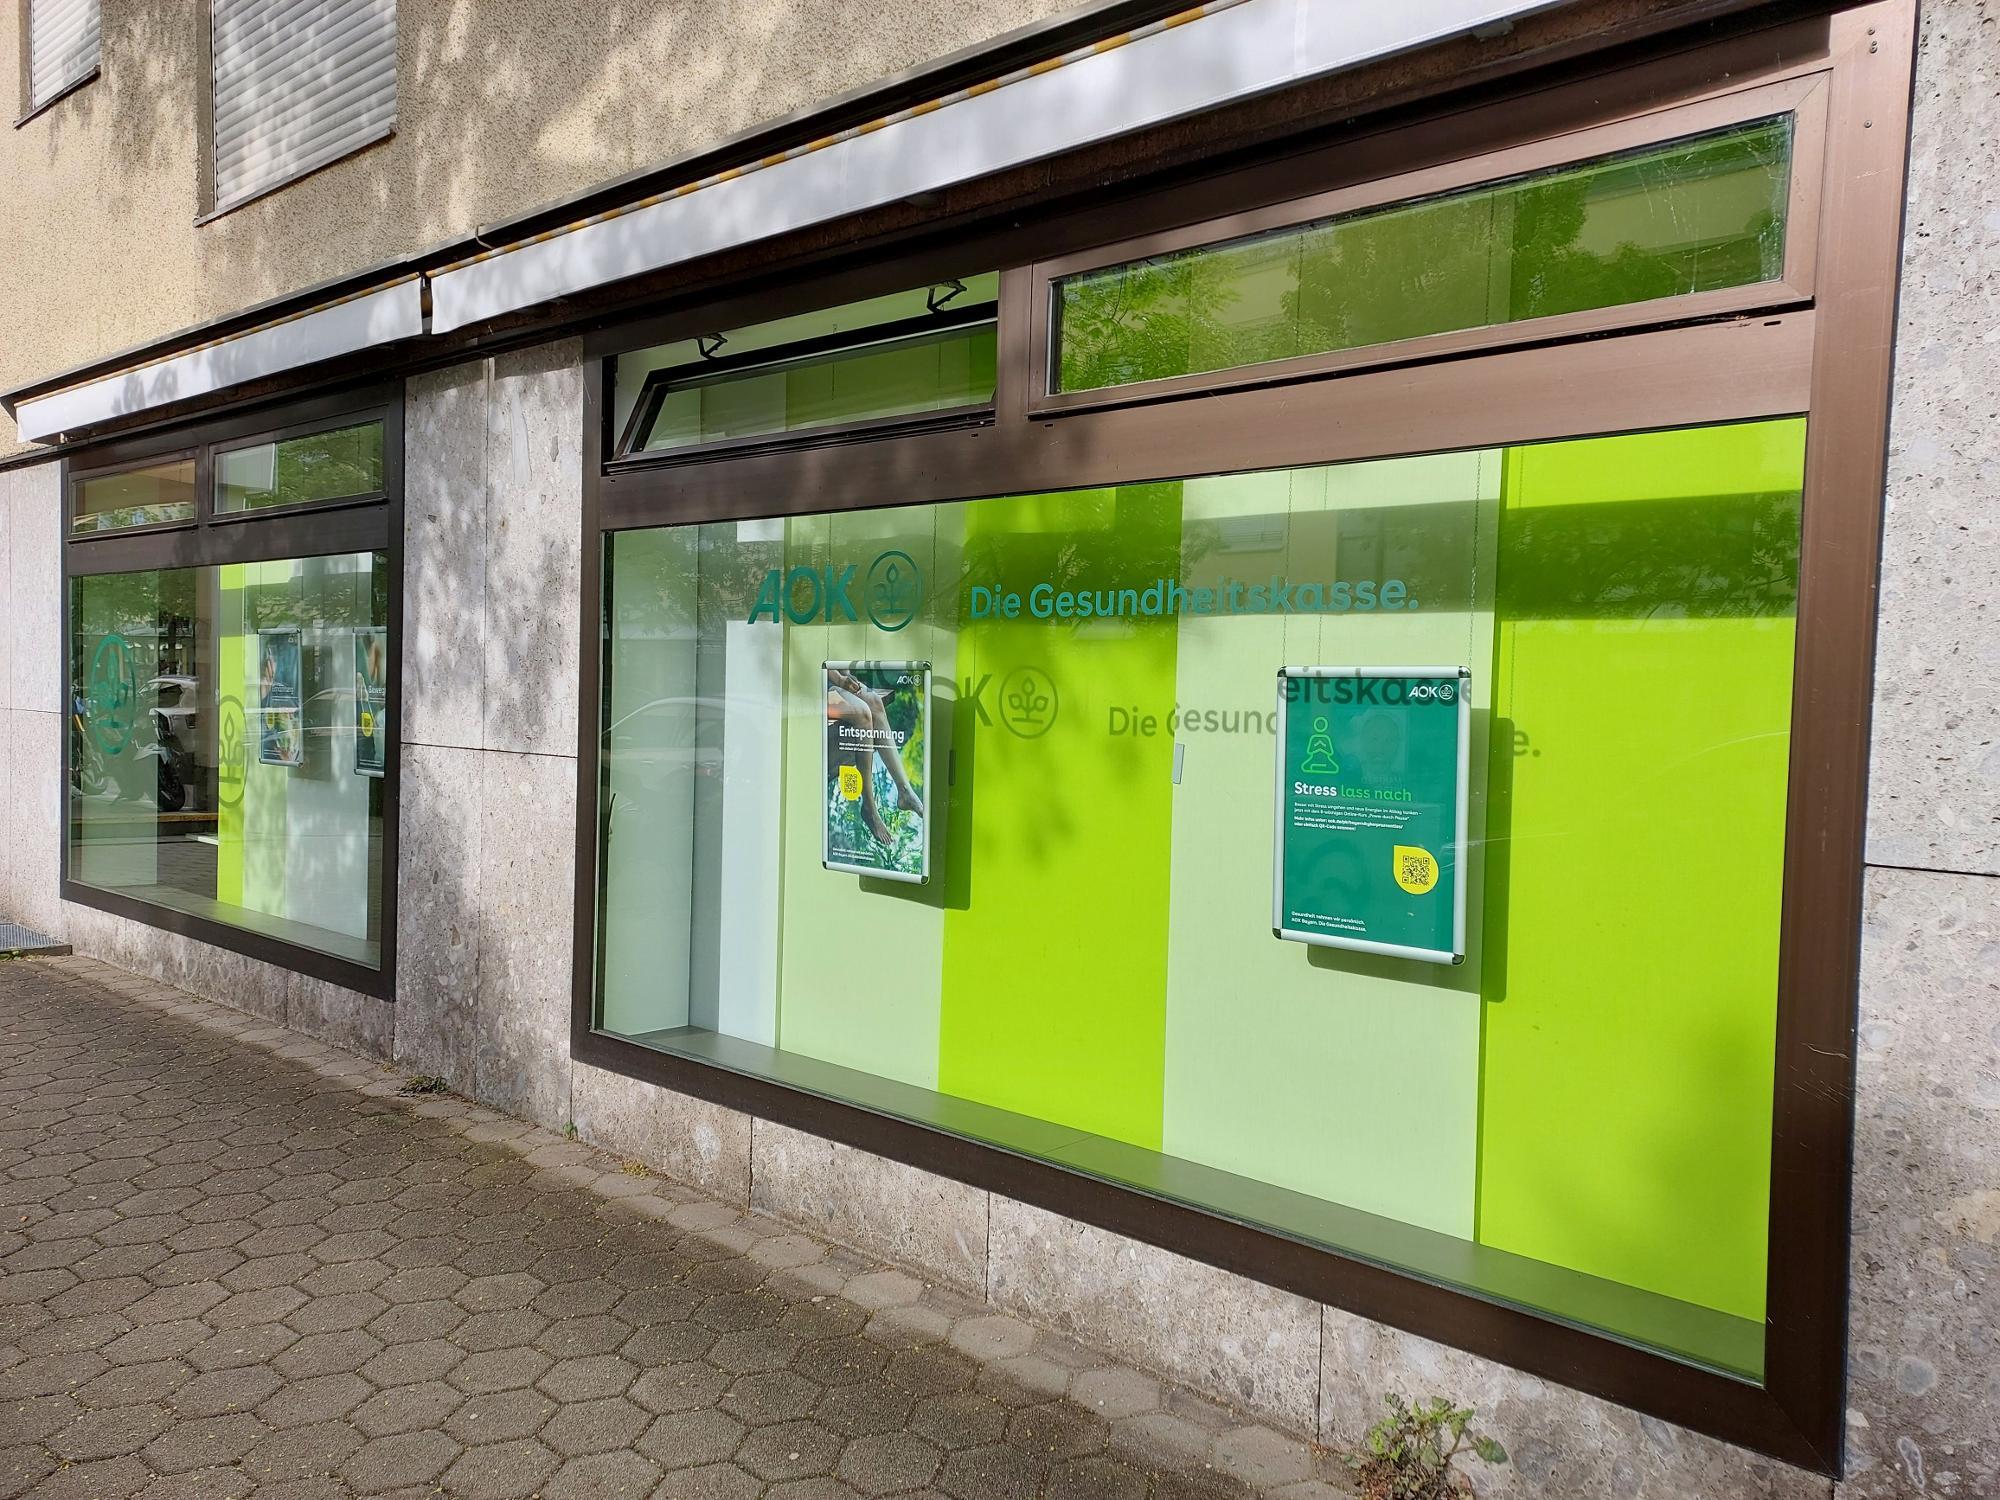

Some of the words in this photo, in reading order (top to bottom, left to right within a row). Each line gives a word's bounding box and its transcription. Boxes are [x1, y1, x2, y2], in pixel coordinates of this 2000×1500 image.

[747, 563, 858, 624] AOK
[971, 584, 1022, 619] Die
[1029, 576, 1420, 618] Gesundheitskasse.
[896, 674, 913, 684] AOK
[1408, 685, 1438, 697] AOK
[1109, 706, 1157, 737] Die
[839, 725, 905, 743] Entspannung
[1294, 781, 1338, 797] Stress
[1340, 784, 1371, 799] lass
[1374, 788, 1412, 801] nach
